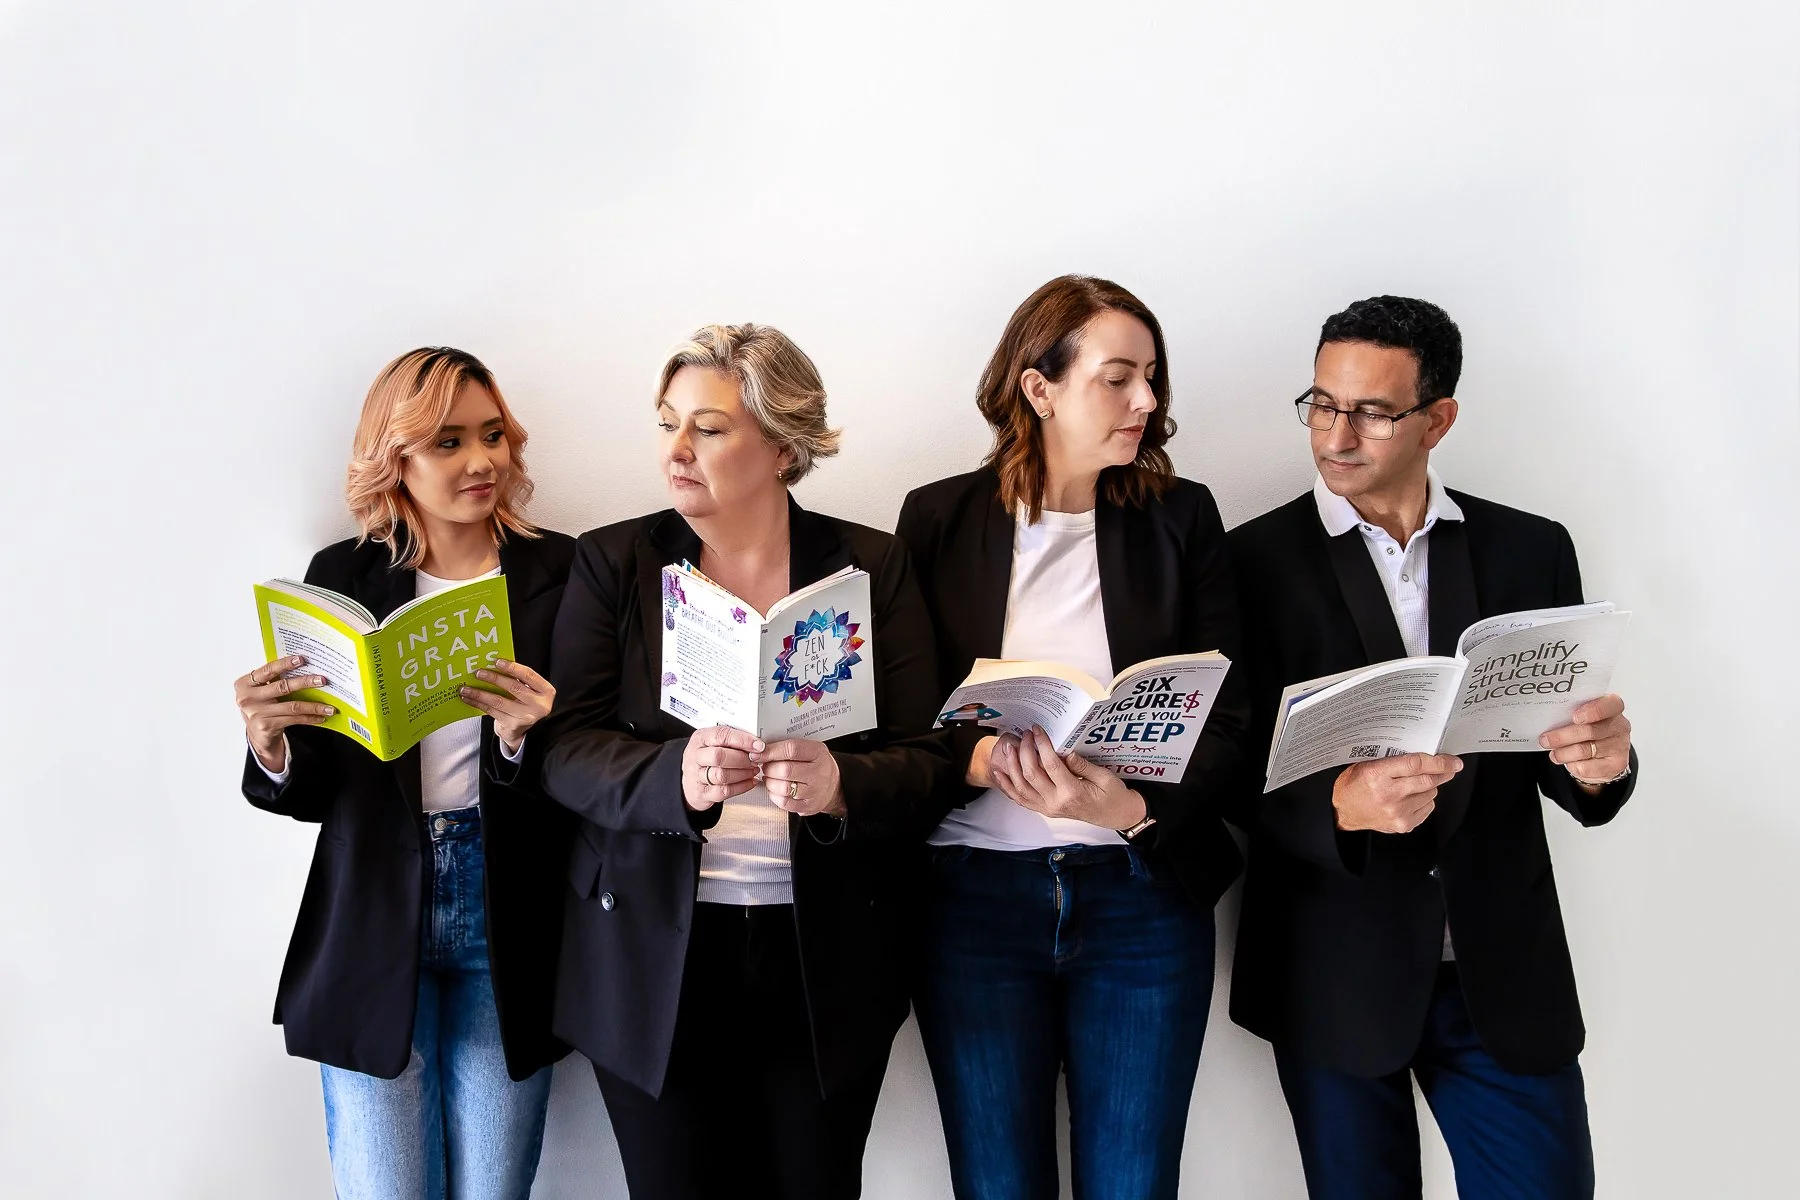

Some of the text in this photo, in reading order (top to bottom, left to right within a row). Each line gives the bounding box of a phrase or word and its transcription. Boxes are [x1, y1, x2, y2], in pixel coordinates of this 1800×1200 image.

[397, 603, 495, 658] INSTA
[400, 626, 499, 680] GRAM
[804, 634, 825, 657] ZEN
[1471, 640, 1579, 679] simplify
[372, 645, 386, 690] INSTAGRAM
[379, 692, 390, 716] RULES
[404, 650, 499, 705] RULES
[1131, 675, 1178, 695] SIX
[1467, 660, 1588, 695] structure
[408, 705, 417, 713] THE
[418, 690, 446, 707] ESSENTIAL
[1462, 675, 1575, 710] succeed
[408, 711, 416, 719] TO
[416, 696, 443, 713] BUILDING
[409, 705, 434, 723] BUSINESS
[1100, 711, 1182, 726] WHILE YOU
[1084, 722, 1186, 745] SLEEP
[1116, 764, 1166, 777] TOON
